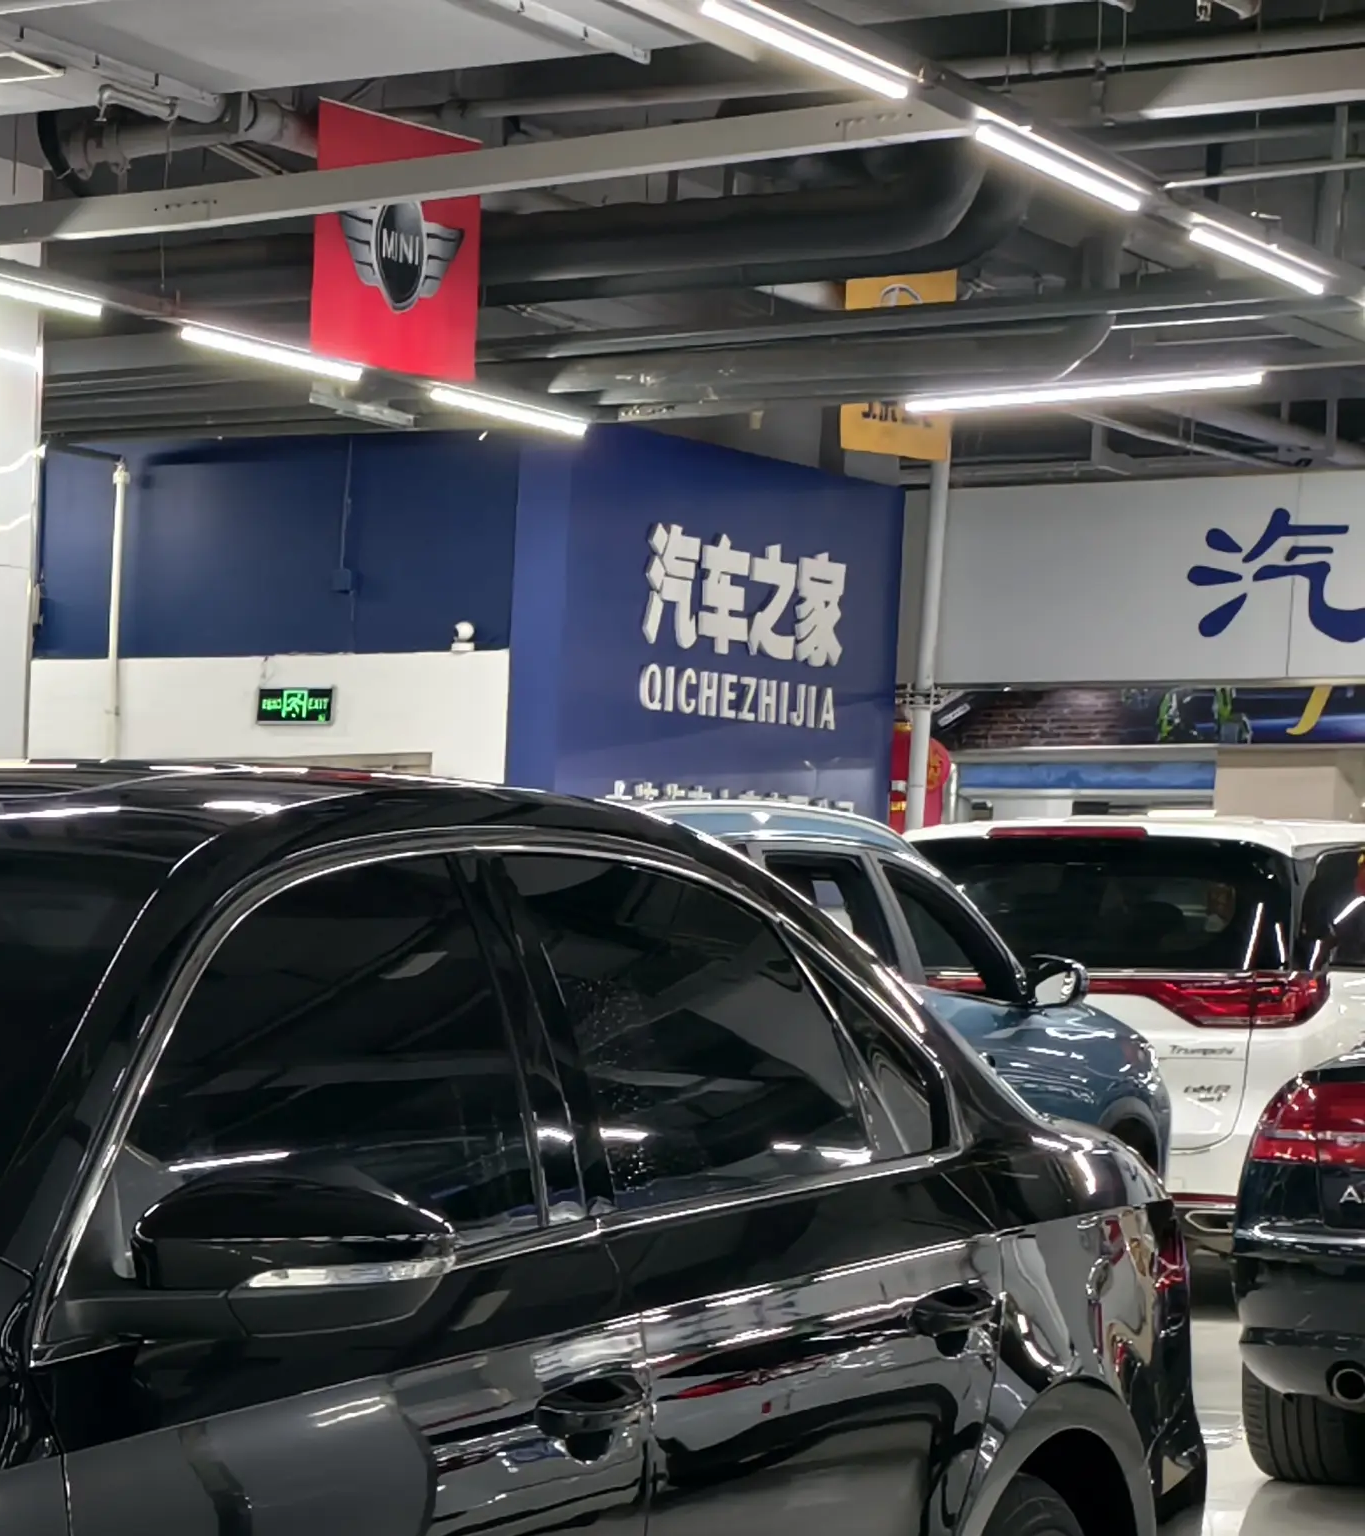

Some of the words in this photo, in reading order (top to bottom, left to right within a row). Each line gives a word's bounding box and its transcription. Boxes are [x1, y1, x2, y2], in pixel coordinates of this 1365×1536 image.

[381, 227, 420, 267] MINI
[640, 521, 848, 668] 汽车之家
[1186, 506, 1365, 644] 汽
[308, 697, 330, 711] EXIT
[638, 662, 836, 731] QICHEZHIJIA
[1339, 1184, 1365, 1204] A
